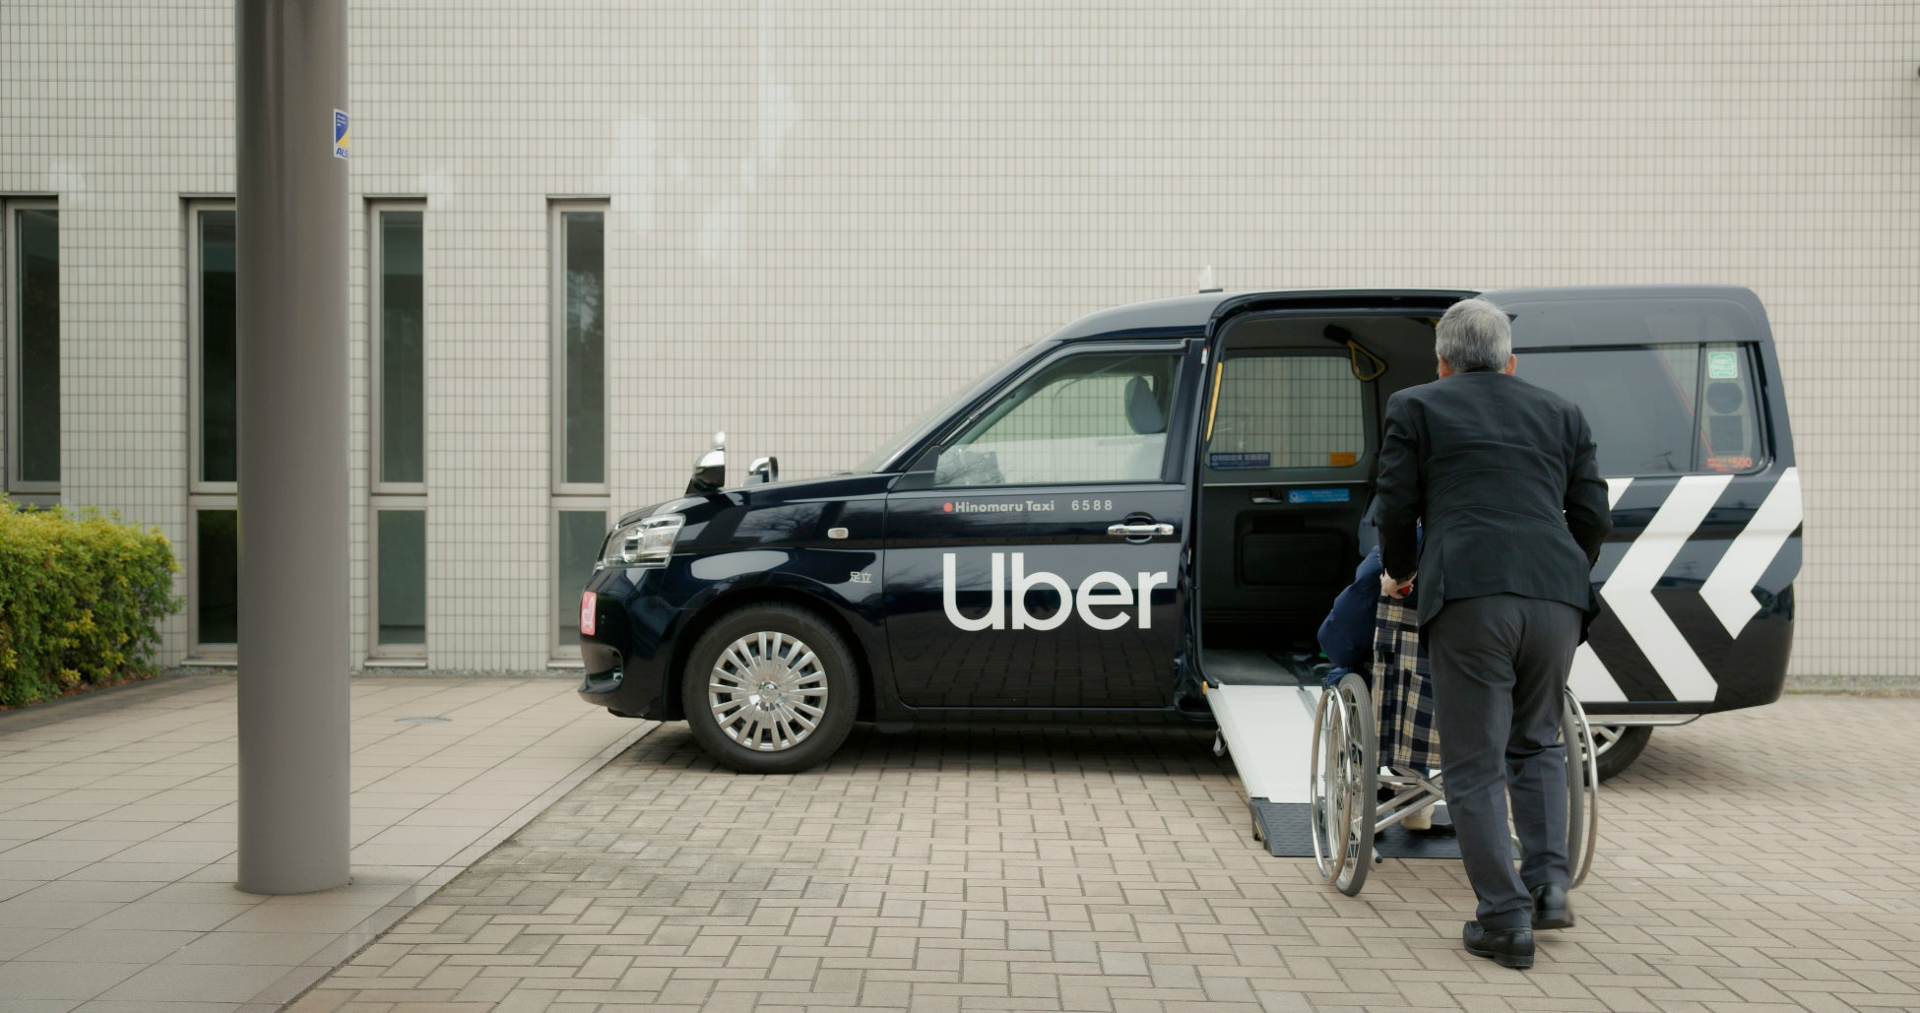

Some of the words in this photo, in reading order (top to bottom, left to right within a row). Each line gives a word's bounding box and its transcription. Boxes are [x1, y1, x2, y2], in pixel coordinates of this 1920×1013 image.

[955, 501, 1024, 513] Hinomaru
[1025, 500, 1055, 512] Taxi
[1071, 499, 1113, 511] 6588
[849, 571, 872, 584] 足立
[942, 552, 1168, 632] Uber
